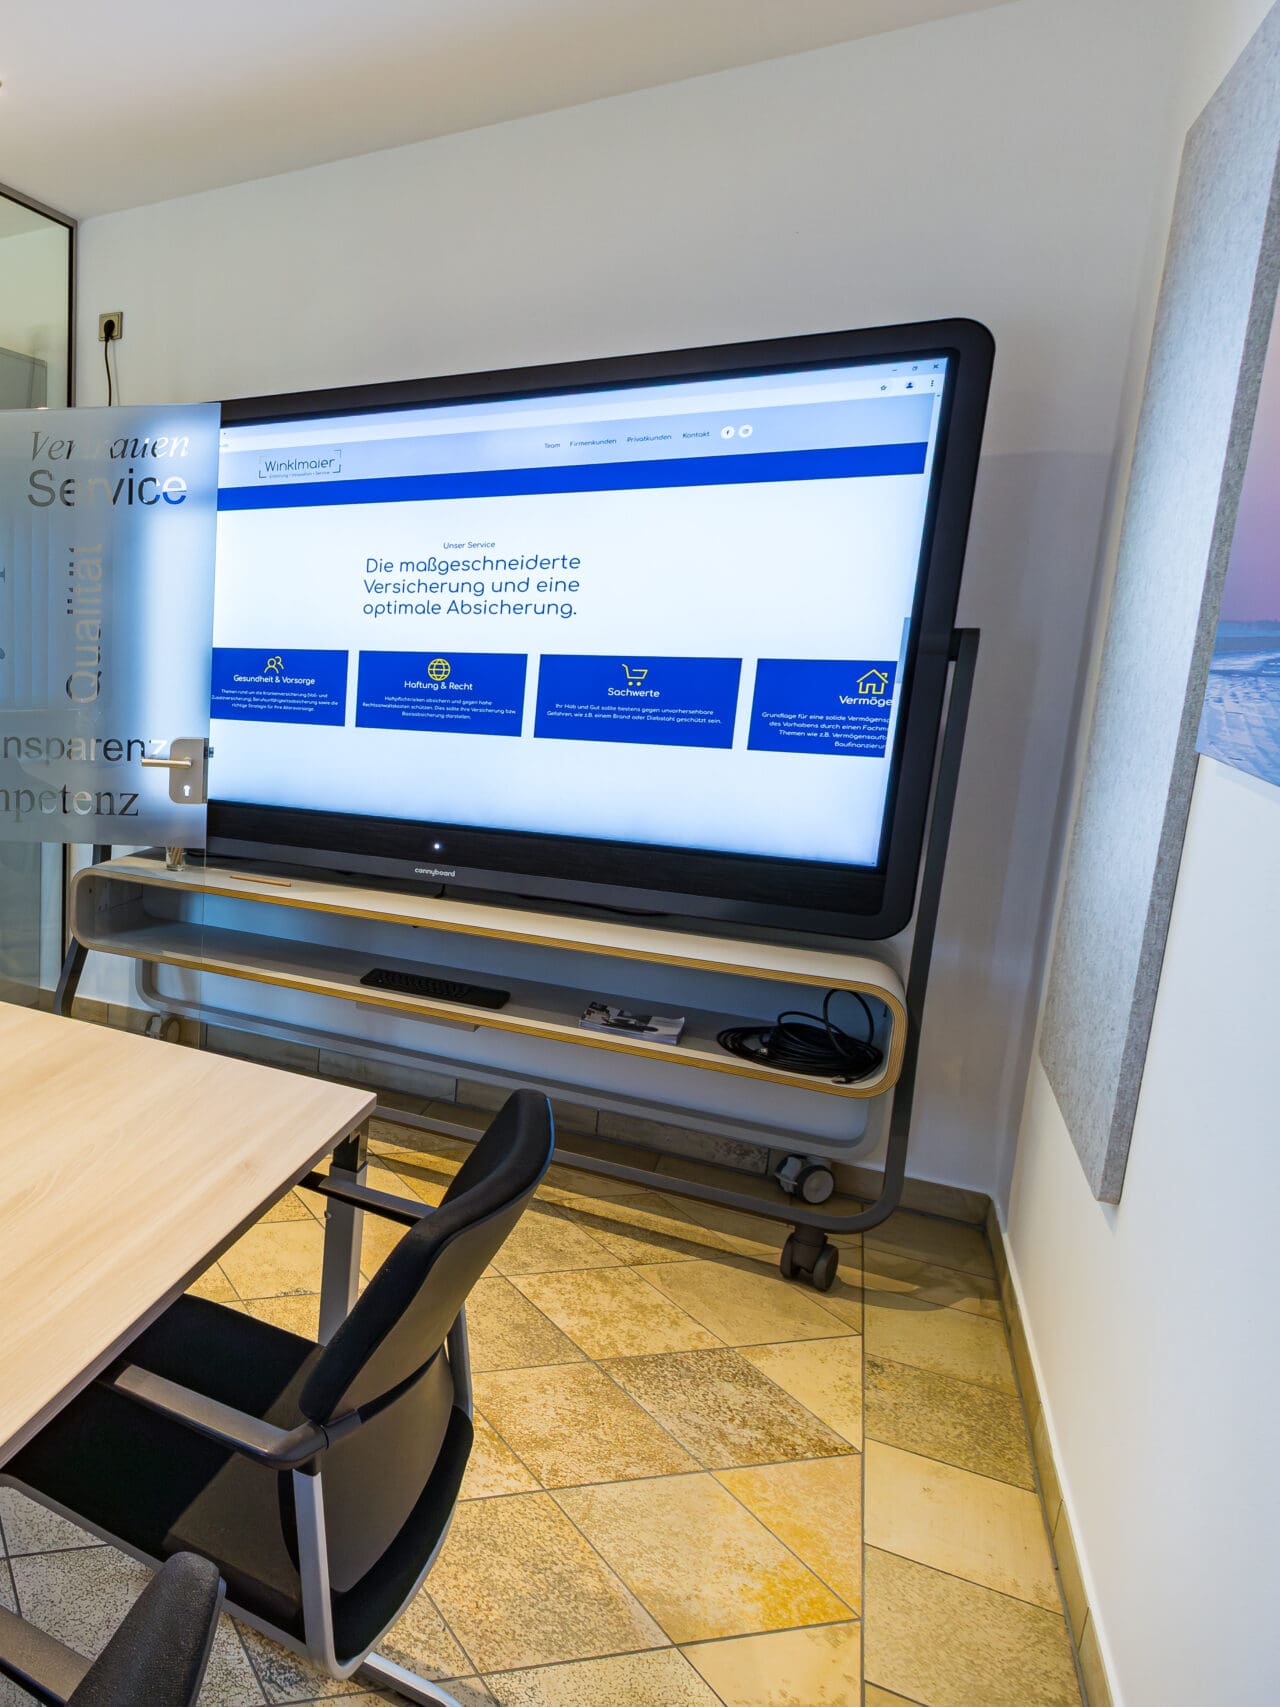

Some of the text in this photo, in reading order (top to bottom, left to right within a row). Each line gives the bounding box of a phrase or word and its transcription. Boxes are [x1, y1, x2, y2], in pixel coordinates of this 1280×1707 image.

[31, 431, 191, 461] Verauen
[569, 438, 617, 448] Firmenkunden
[627, 433, 672, 443] Privatkunden
[682, 430, 710, 439] Kontakt
[265, 459, 335, 472] Winklmaier
[28, 468, 188, 507] Service
[443, 541, 496, 549] Unser Service
[366, 555, 581, 575] Die maßgeschneiderte
[363, 577, 580, 596] Versicherung und eine
[363, 600, 577, 618] optimale Absicherung.
[234, 675, 273, 683] Gesundheit
[282, 676, 315, 686] Vorsorge
[404, 681, 473, 691] Haftung & Recht
[607, 687, 660, 698] Sachwerte
